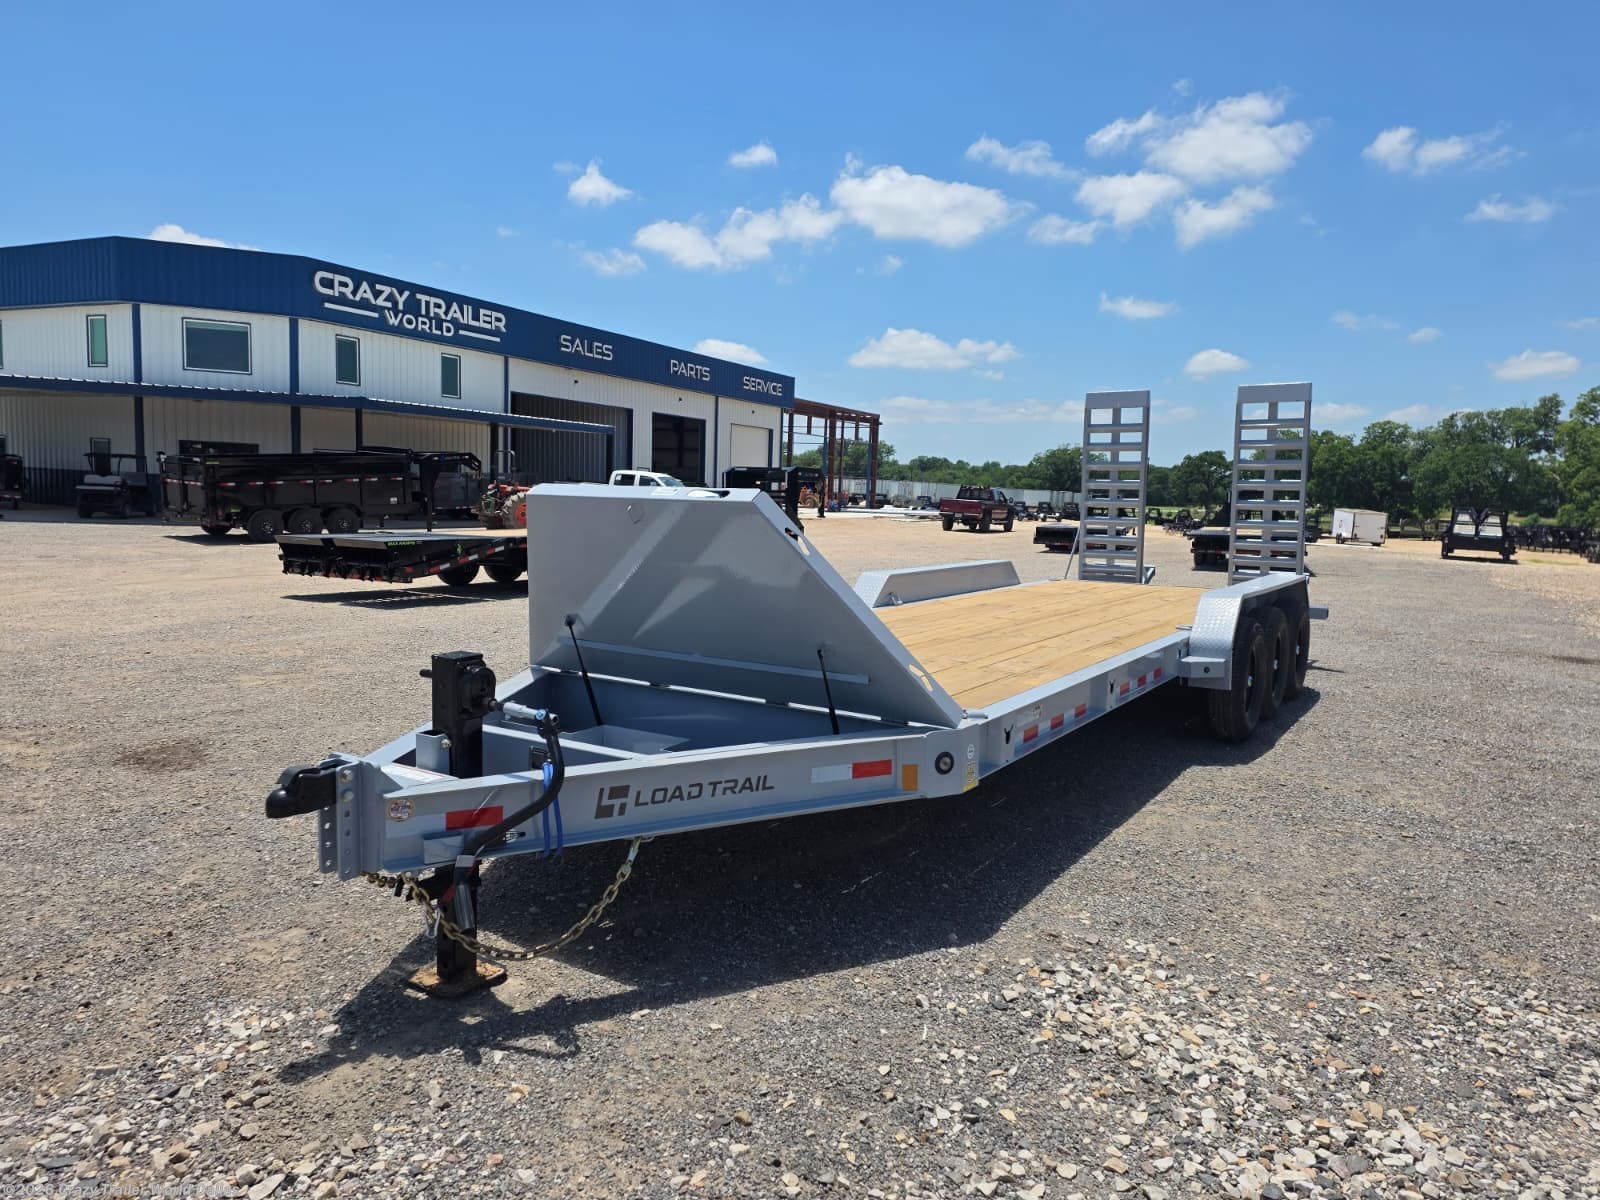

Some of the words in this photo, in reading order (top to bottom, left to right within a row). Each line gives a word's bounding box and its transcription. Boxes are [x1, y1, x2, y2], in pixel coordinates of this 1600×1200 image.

[314, 270, 410, 310] CRAZY
[416, 293, 506, 332] TRAILER
[385, 309, 454, 336] WORLD
[560, 334, 613, 361] SALES
[670, 359, 711, 381] PARTS
[743, 376, 783, 396] SERVICE
[634, 782, 703, 807] LOAD
[708, 774, 775, 798] TRAIL
